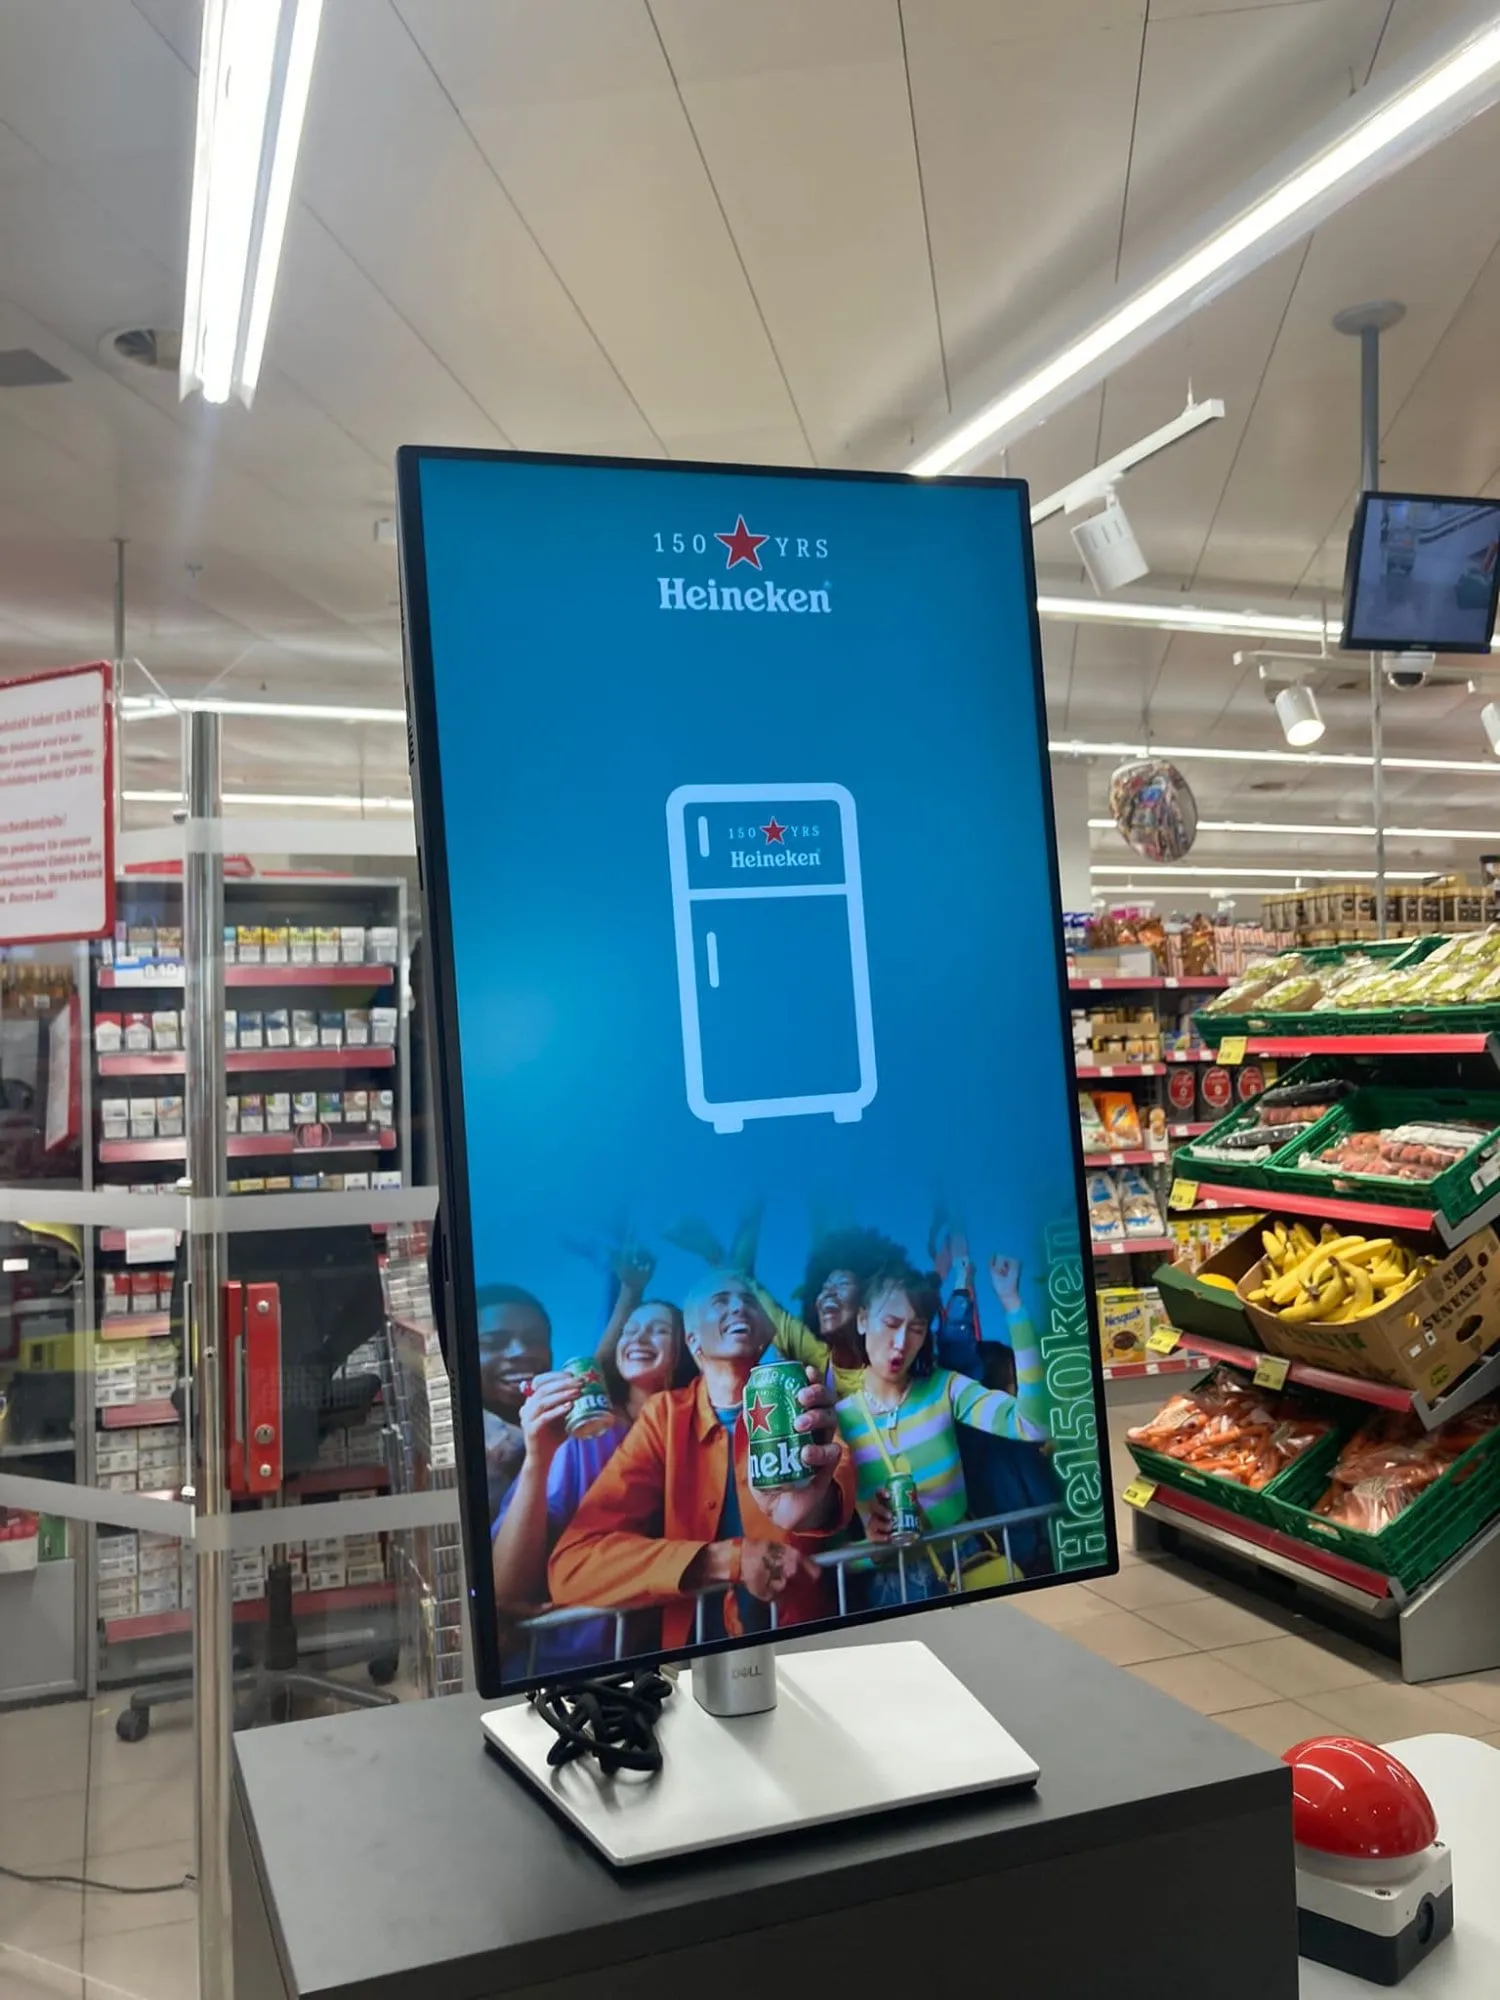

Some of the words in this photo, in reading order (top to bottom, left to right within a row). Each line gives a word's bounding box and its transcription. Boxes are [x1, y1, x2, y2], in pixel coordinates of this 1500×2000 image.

[653, 532, 706, 554] 150
[775, 537, 828, 559] YRS
[657, 577, 832, 613] Heineken
[729, 827, 756, 840] 150
[791, 825, 820, 838] YRS
[730, 849, 821, 868] Heineken
[1042, 1223, 1107, 1573] He150ken
